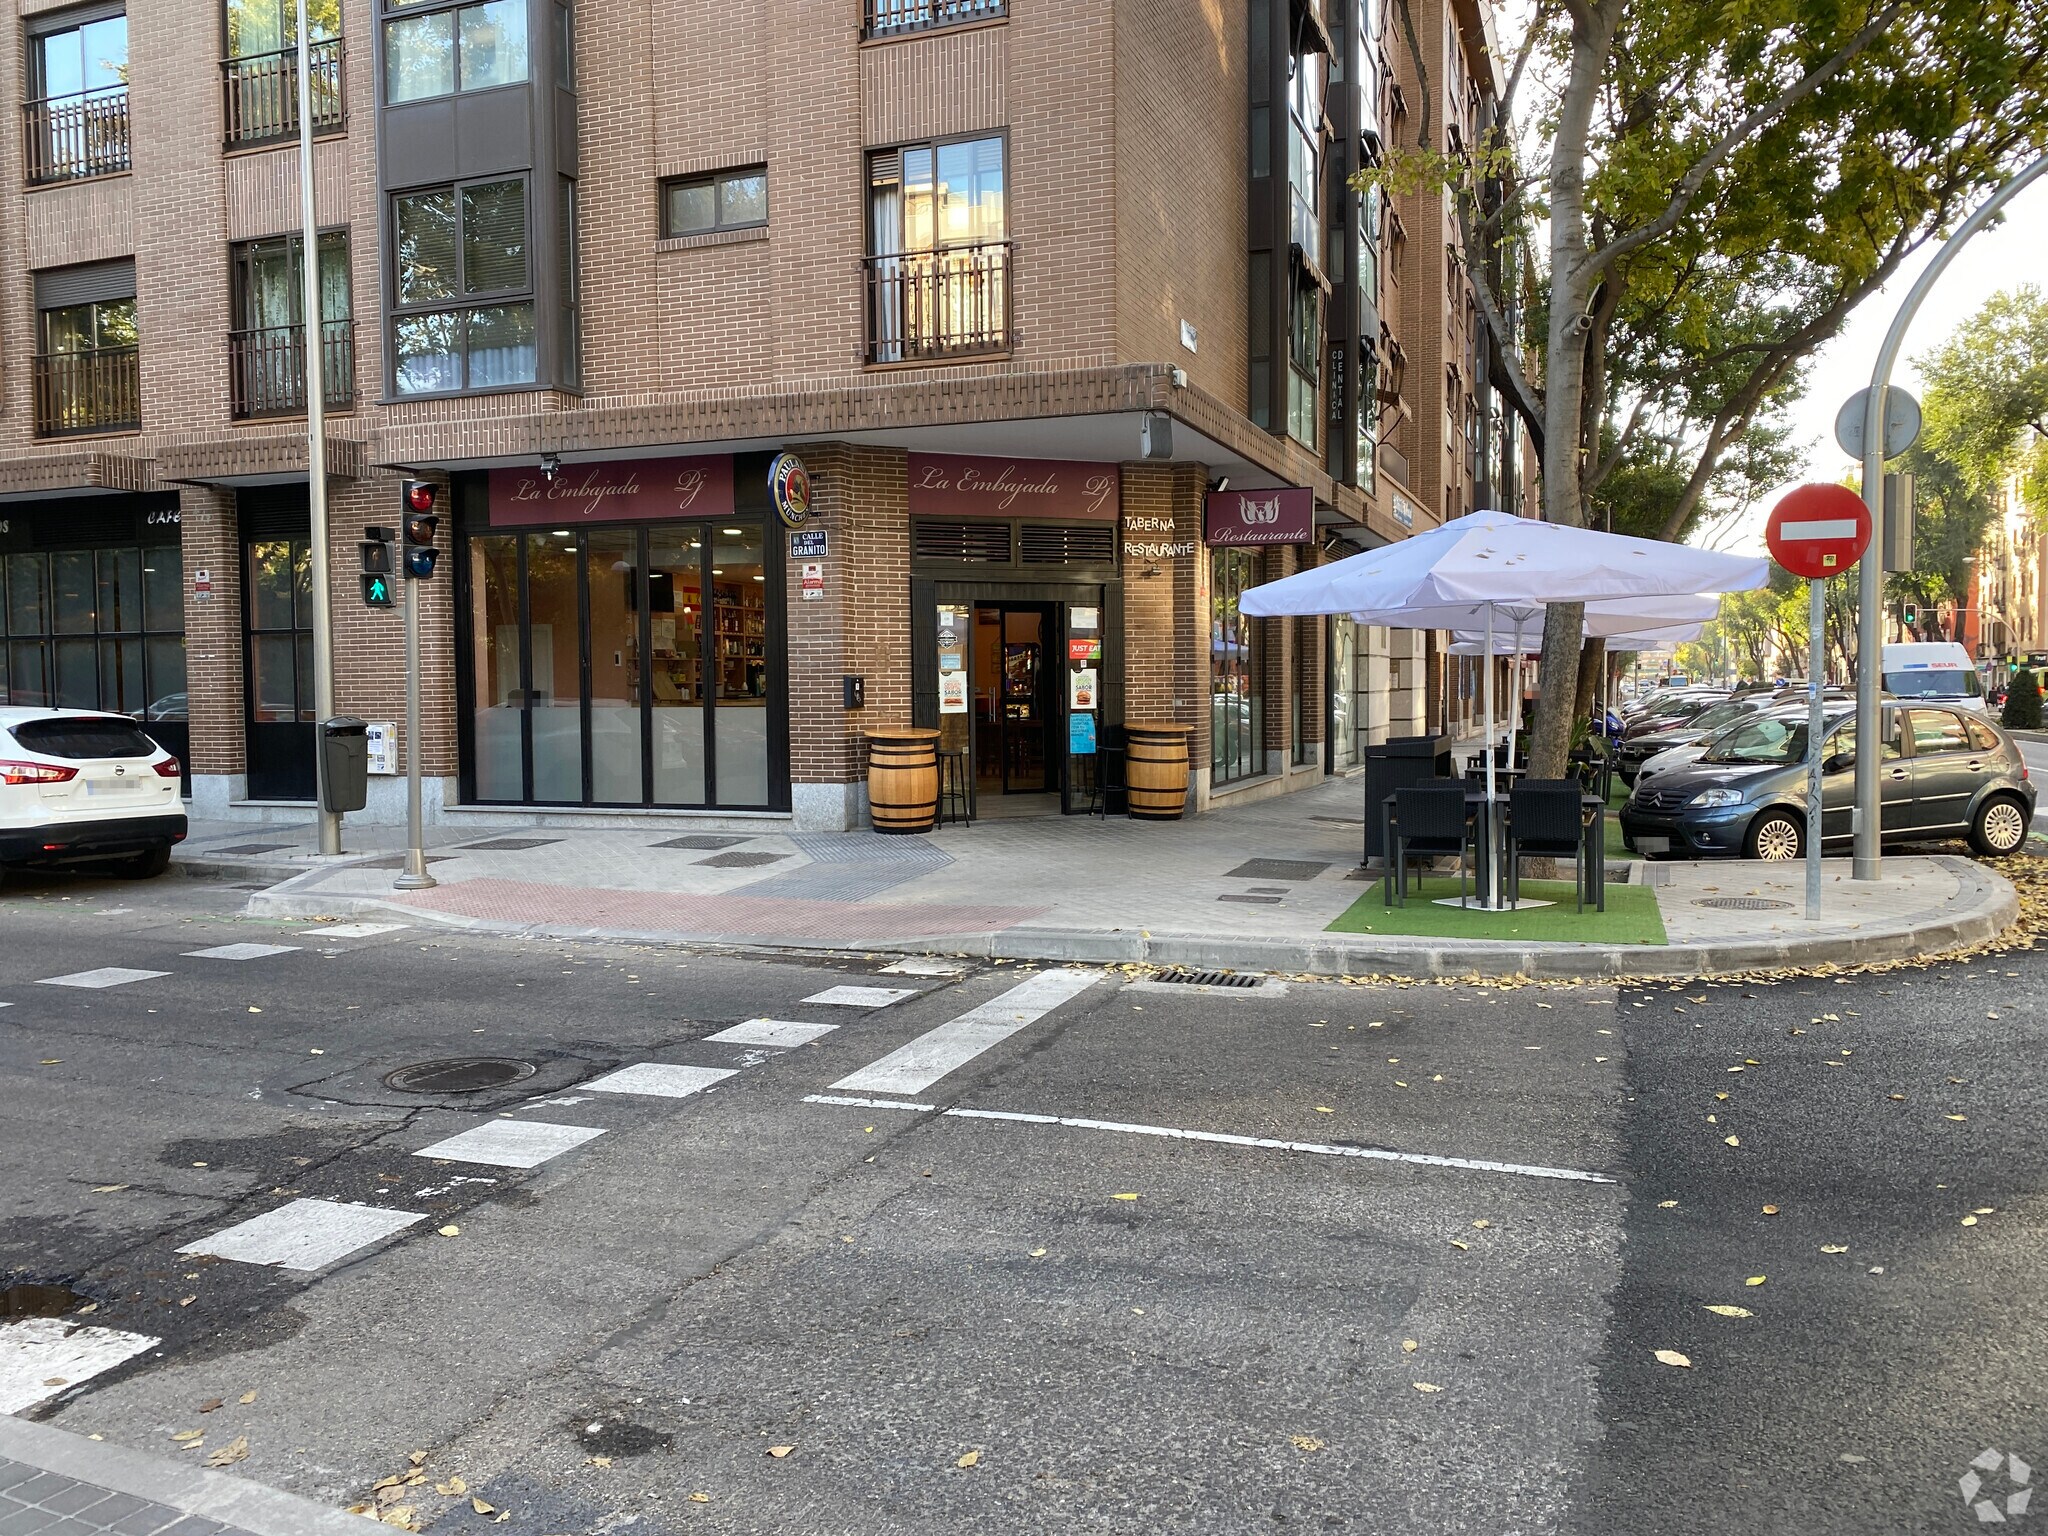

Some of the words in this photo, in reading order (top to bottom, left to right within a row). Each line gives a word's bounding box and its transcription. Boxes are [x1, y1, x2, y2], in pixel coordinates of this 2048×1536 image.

[510, 478, 542, 501] La
[547, 468, 640, 514] Embajada
[914, 465, 950, 489] La
[956, 464, 1060, 510] Embajada
[1124, 516, 1176, 532] TABERNA
[802, 532, 824, 541] CALLE
[1208, 525, 1308, 543] Restaurante
[792, 544, 826, 556] GRANITO
[1124, 542, 1195, 558] RESTAURANTE
[1071, 644, 1088, 653] JUST
[1088, 644, 1102, 652] EAT
